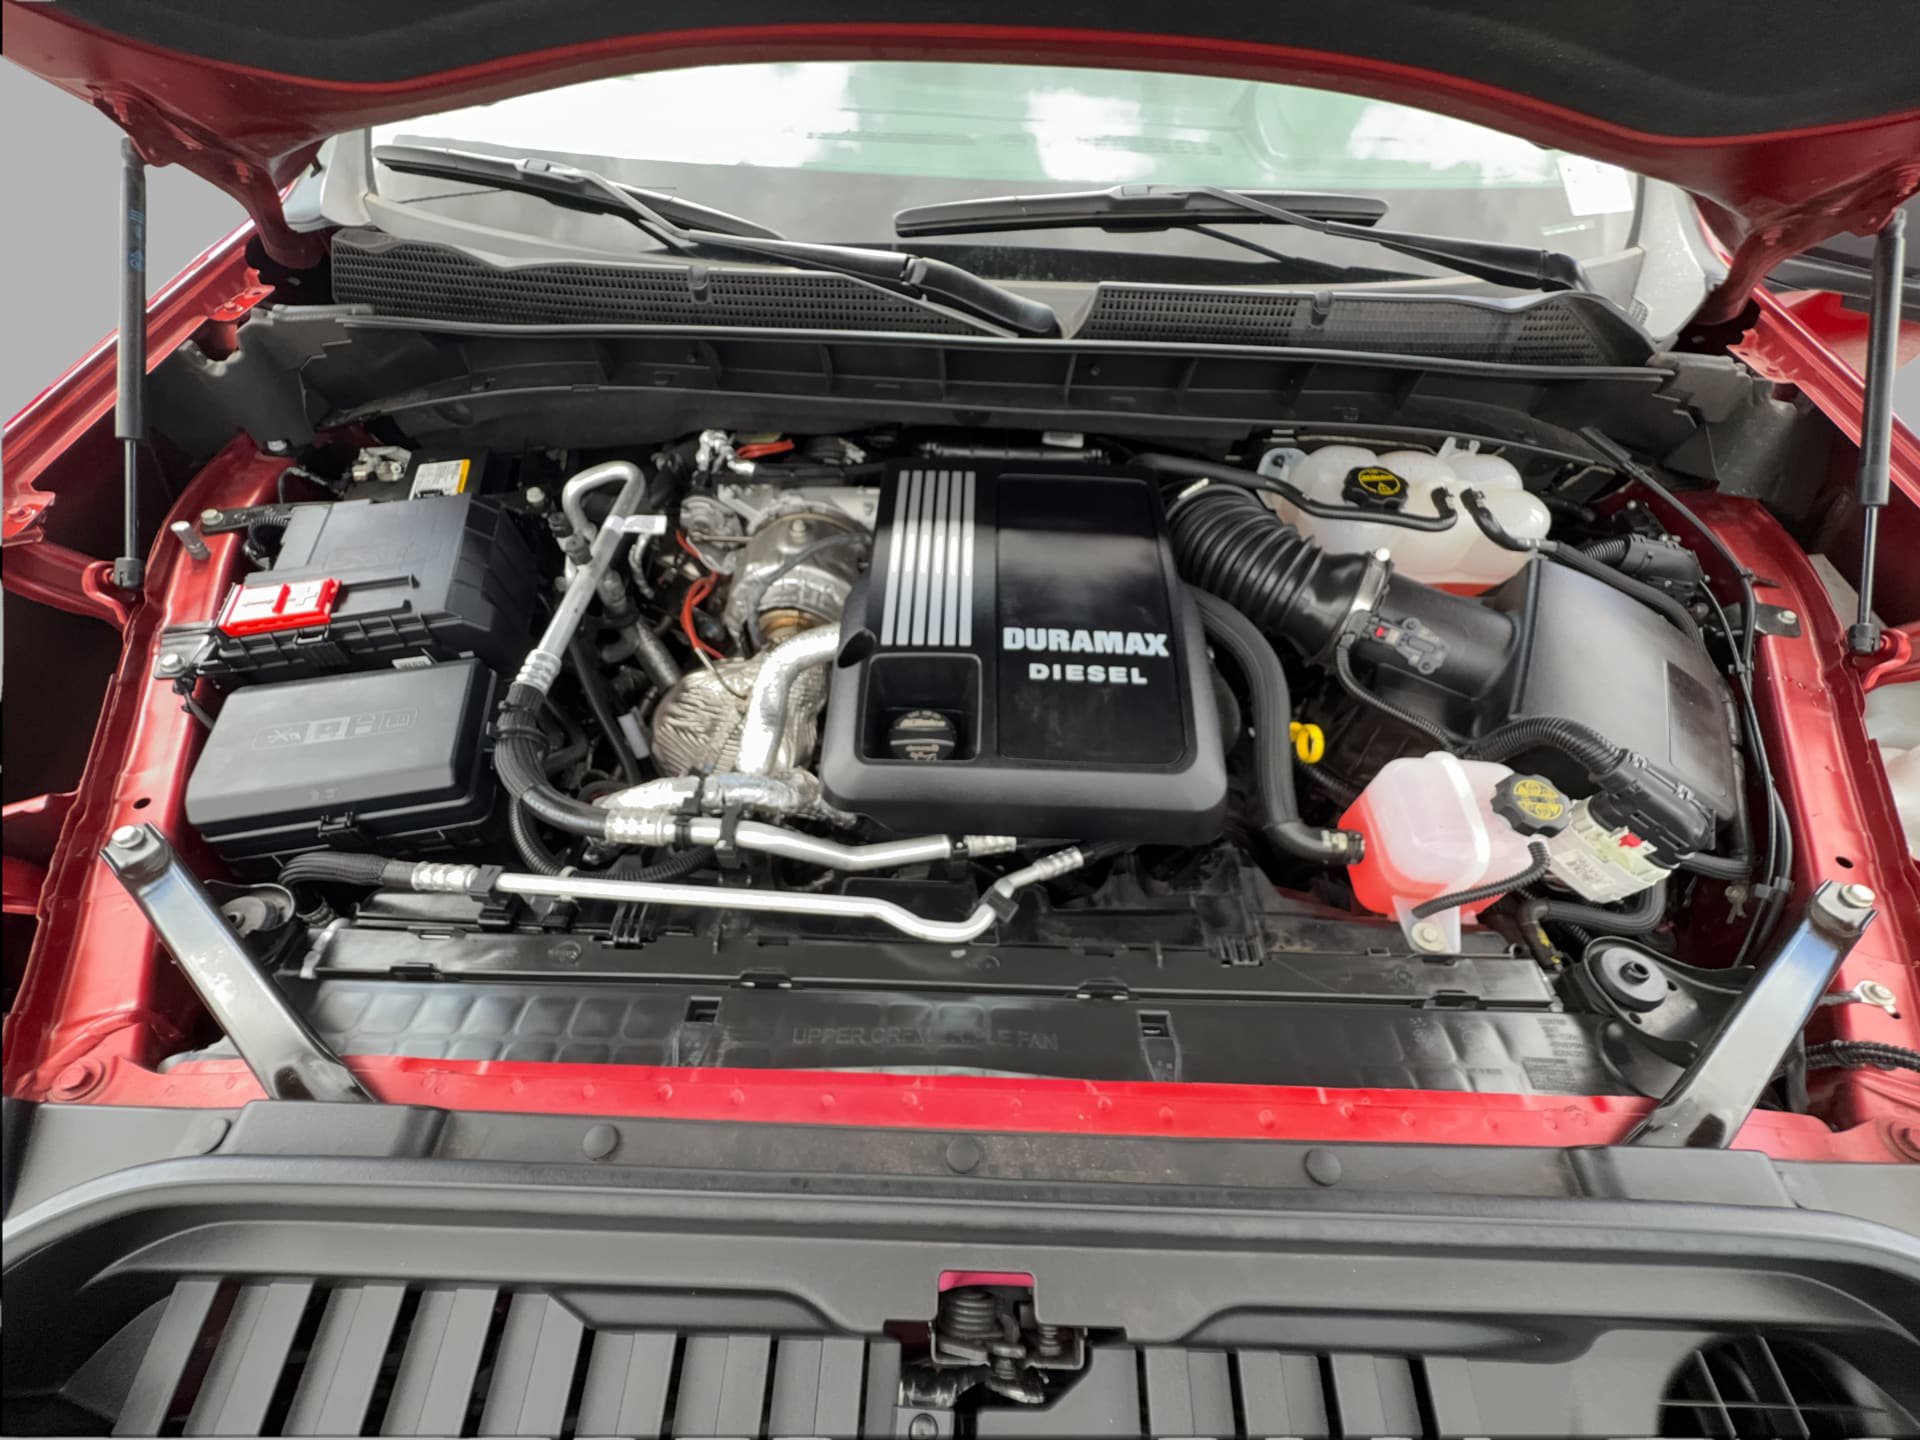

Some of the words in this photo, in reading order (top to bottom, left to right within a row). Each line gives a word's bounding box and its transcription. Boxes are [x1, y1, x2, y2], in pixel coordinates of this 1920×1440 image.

[1003, 626, 1169, 657] DURAMAX
[1029, 663, 1148, 684] DIESEL
[791, 1026, 866, 1046] UPPER
